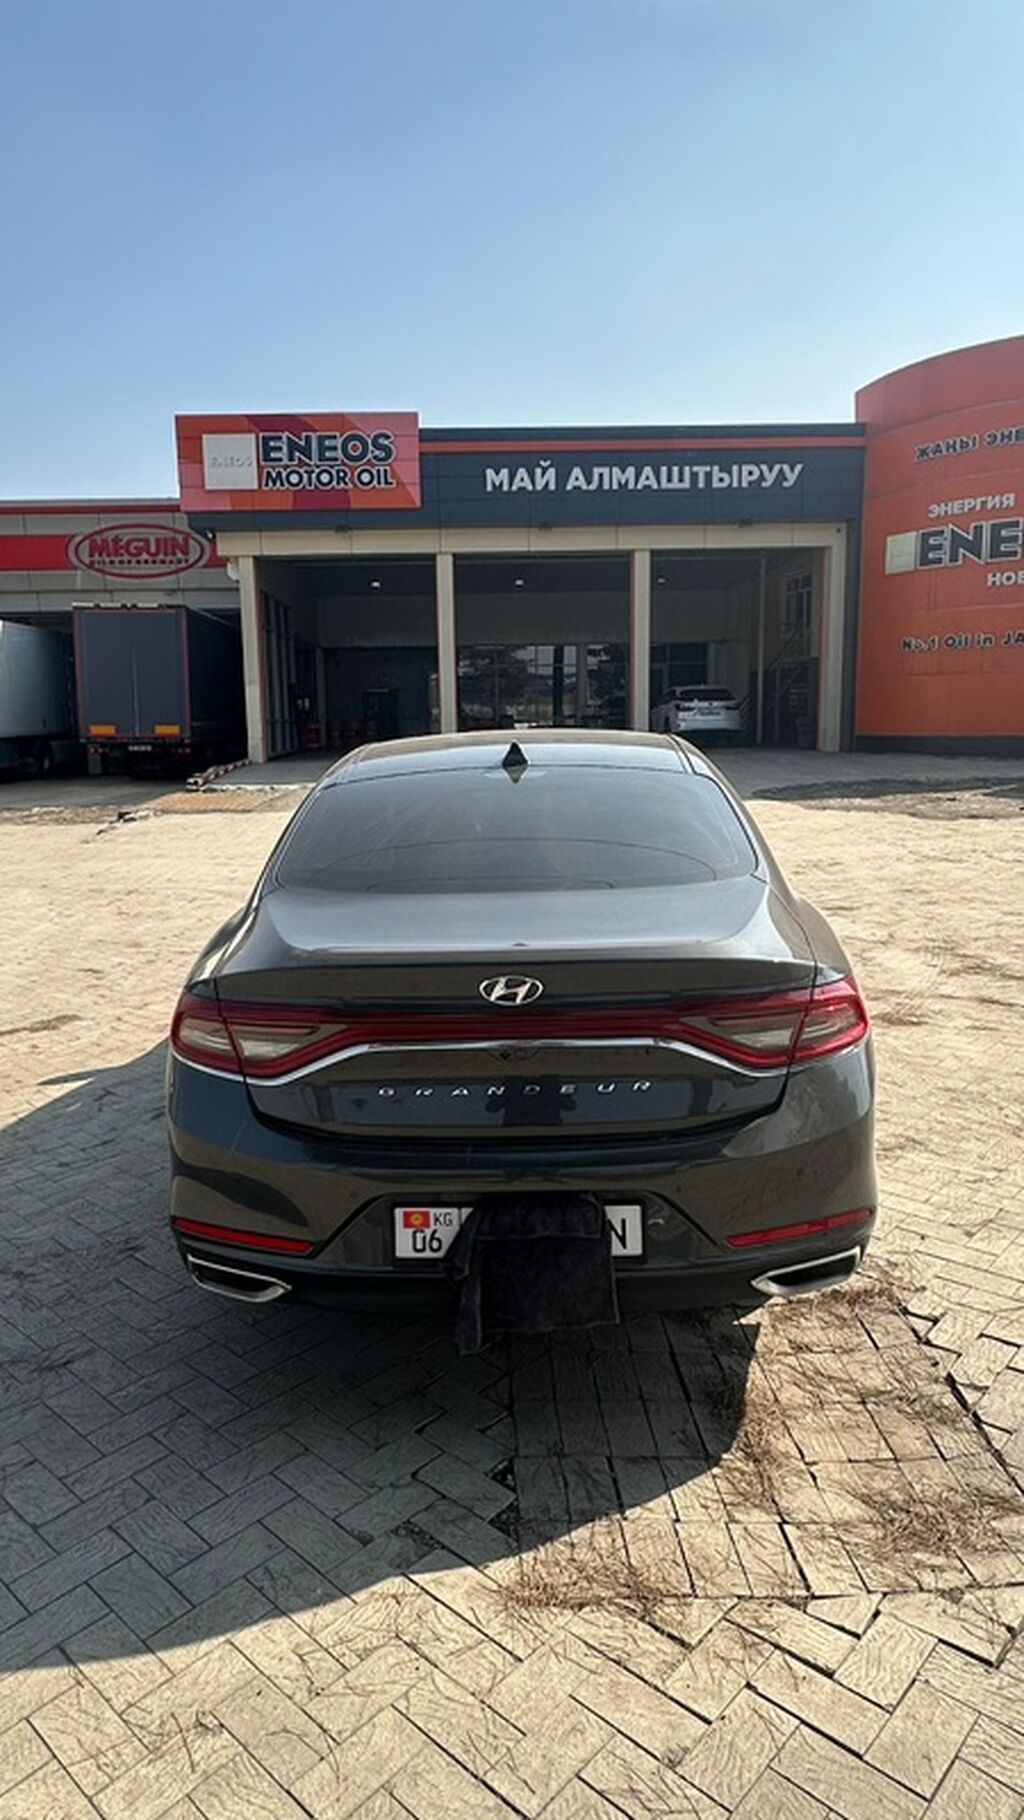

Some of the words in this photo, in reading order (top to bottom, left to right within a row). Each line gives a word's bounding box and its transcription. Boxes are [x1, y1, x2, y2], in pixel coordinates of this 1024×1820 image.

[260, 431, 395, 464] ENEOS
[263, 467, 350, 489] MOTOR
[356, 467, 395, 488] OIL
[486, 460, 556, 491] МАЙ
[566, 463, 804, 490] АЛМАШТЫРУУ
[928, 493, 1015, 517] ЭНЕРГИЯ
[944, 632, 970, 650] Oil
[977, 632, 995, 647] in
[378, 1080, 651, 1097] GRANDEUR
[433, 1212, 452, 1227] KG
[412, 1229, 442, 1253] 06
